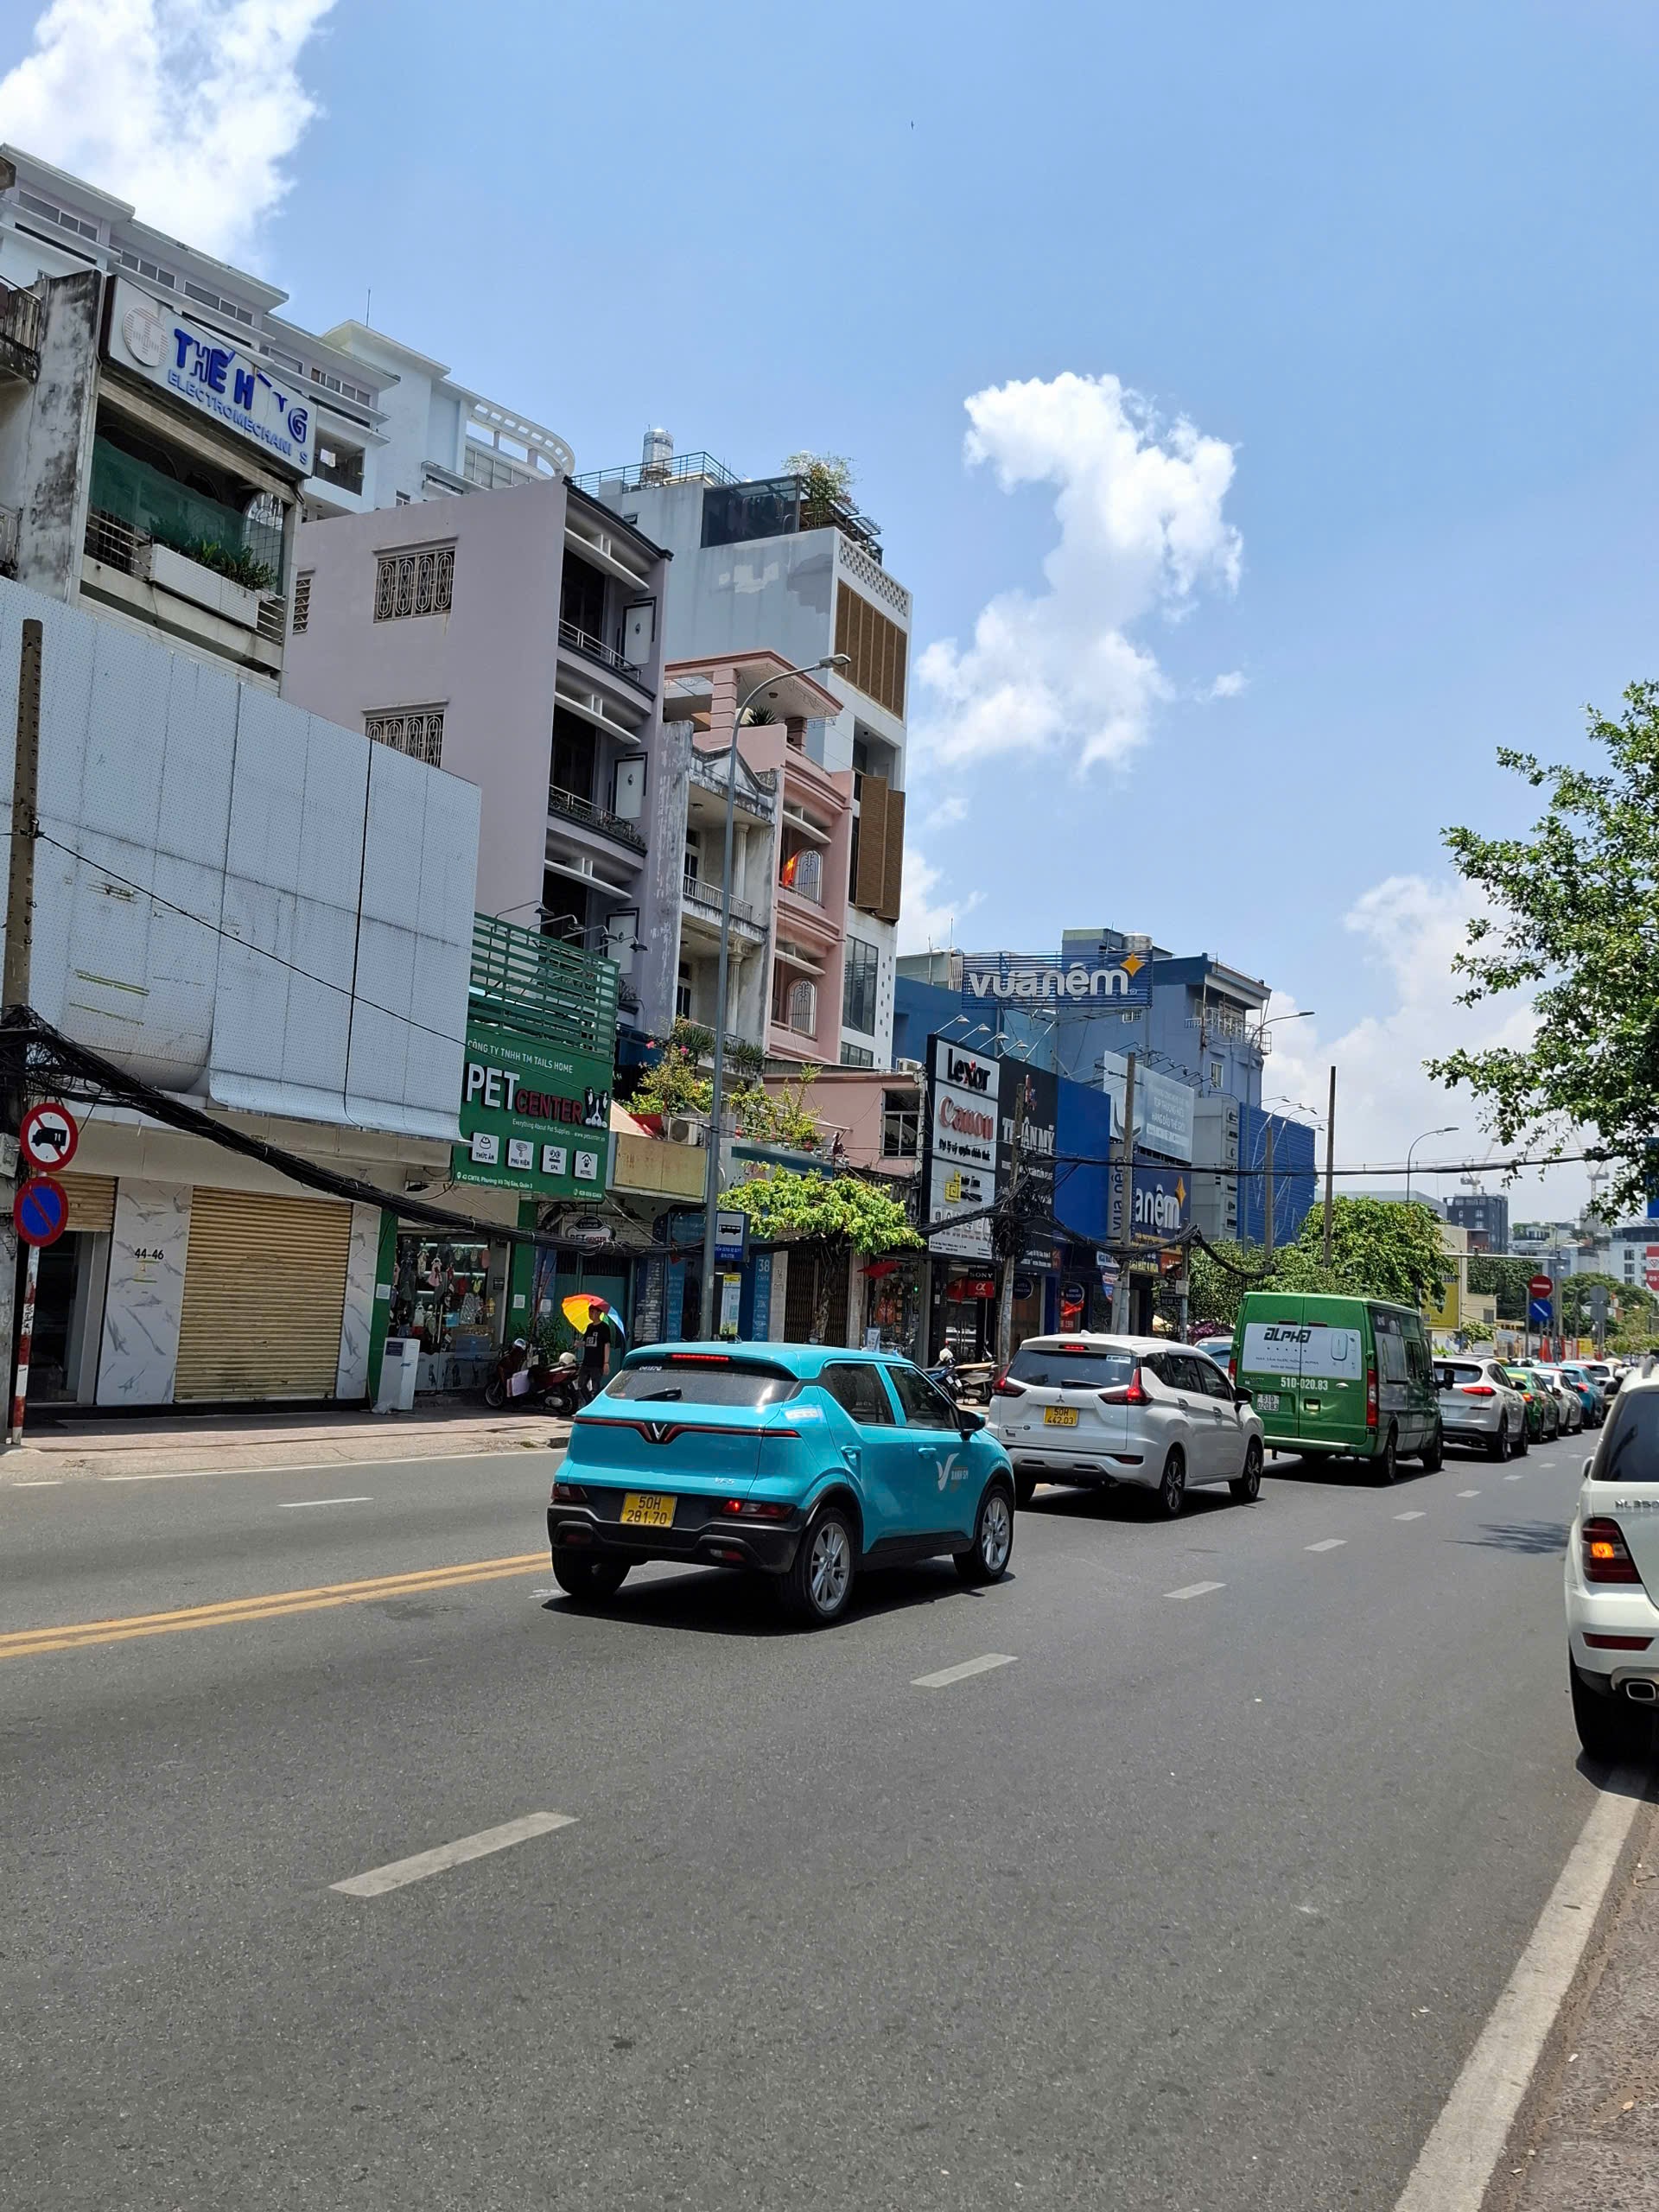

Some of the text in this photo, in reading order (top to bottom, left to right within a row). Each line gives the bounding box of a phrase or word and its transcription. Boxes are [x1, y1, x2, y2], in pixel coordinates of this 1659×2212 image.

[167, 369, 308, 465] ELECTROMECHANIS
[467, 1039, 574, 1074] CÔNG TY TNHH TM TAILS HOME
[466, 1062, 583, 1125] PET CENTER
[938, 1096, 994, 1141] Canon
[134, 1248, 165, 1261] 44-46
[759, 1258, 771, 1273] 38
[1281, 1376, 1329, 1391] 51D-020.83
[1053, 1407, 1070, 1416] 50H
[1046, 1416, 1074, 1425] 442.03
[638, 1496, 662, 1510] 50H
[626, 1510, 668, 1525] 281.70
